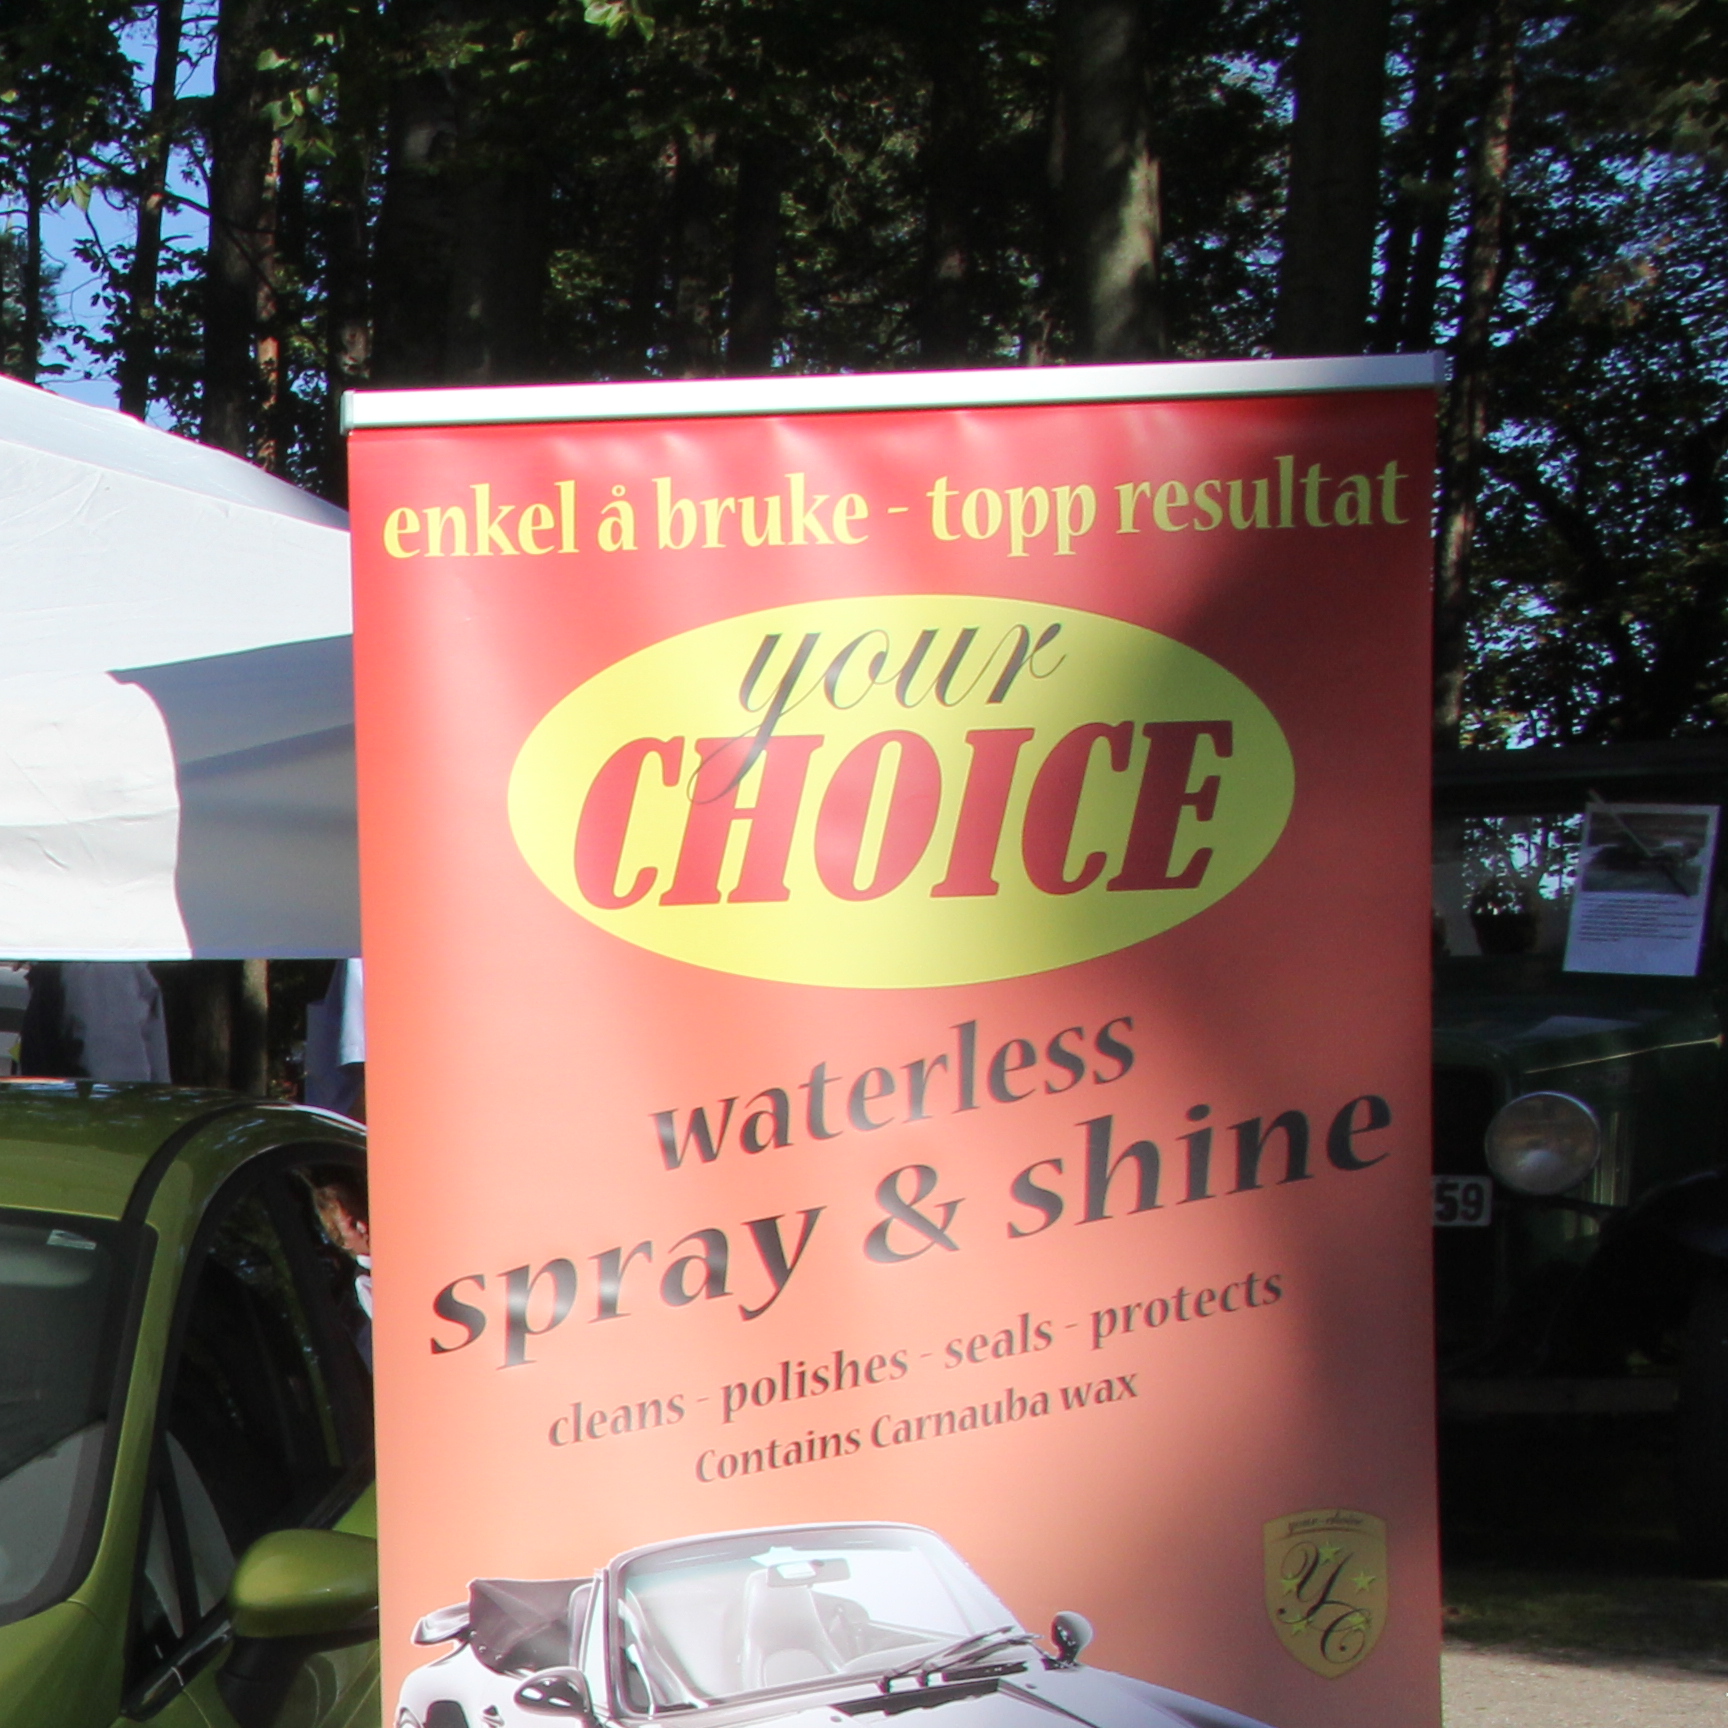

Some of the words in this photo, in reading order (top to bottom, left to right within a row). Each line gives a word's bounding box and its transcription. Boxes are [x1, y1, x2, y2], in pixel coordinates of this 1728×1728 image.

[382, 481, 579, 560] enkel
[597, 485, 636, 552] å
[657, 473, 869, 549] bruke
[926, 473, 1097, 557] topp
[1115, 454, 1410, 537] resultat
[686, 621, 1066, 805] your
[573, 719, 1234, 910] CHOICE
[648, 1014, 1136, 1172] waterless
[429, 1202, 824, 1371] spray
[862, 1164, 965, 1265] &
[1006, 1092, 1393, 1243] shine
[547, 1393, 685, 1448] cleans
[719, 1349, 909, 1424] polishes
[944, 1311, 1053, 1370] seals
[1088, 1270, 1283, 1351] protects
[694, 1426, 861, 1483] Contains
[869, 1386, 1051, 1449] Carnauba
[1059, 1371, 1138, 1412] wax
